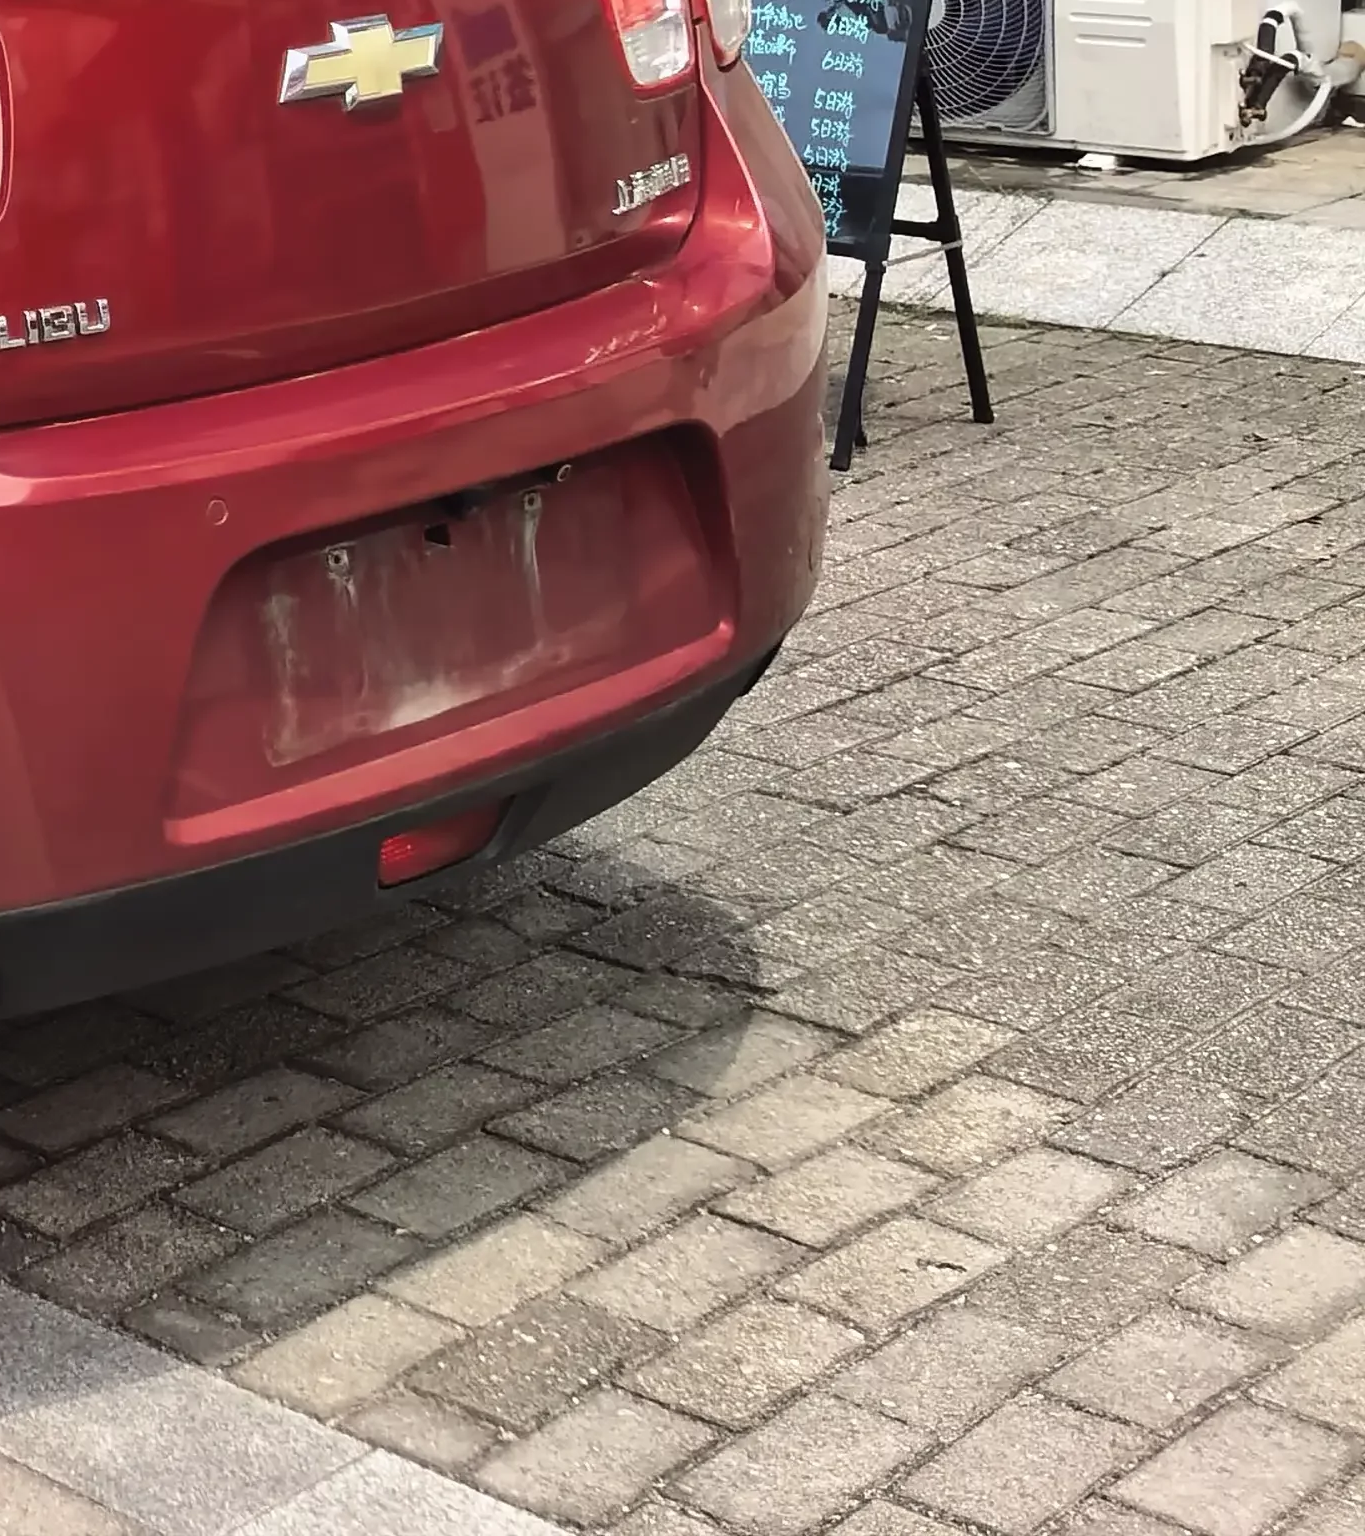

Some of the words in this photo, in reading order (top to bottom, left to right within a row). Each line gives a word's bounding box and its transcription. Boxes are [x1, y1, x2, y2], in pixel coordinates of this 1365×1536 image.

[827, 14, 871, 44] 6日游
[822, 51, 866, 78] 6日游
[814, 88, 856, 119] 5日游
[811, 118, 854, 147] 5日游
[803, 144, 851, 172] 5日游
